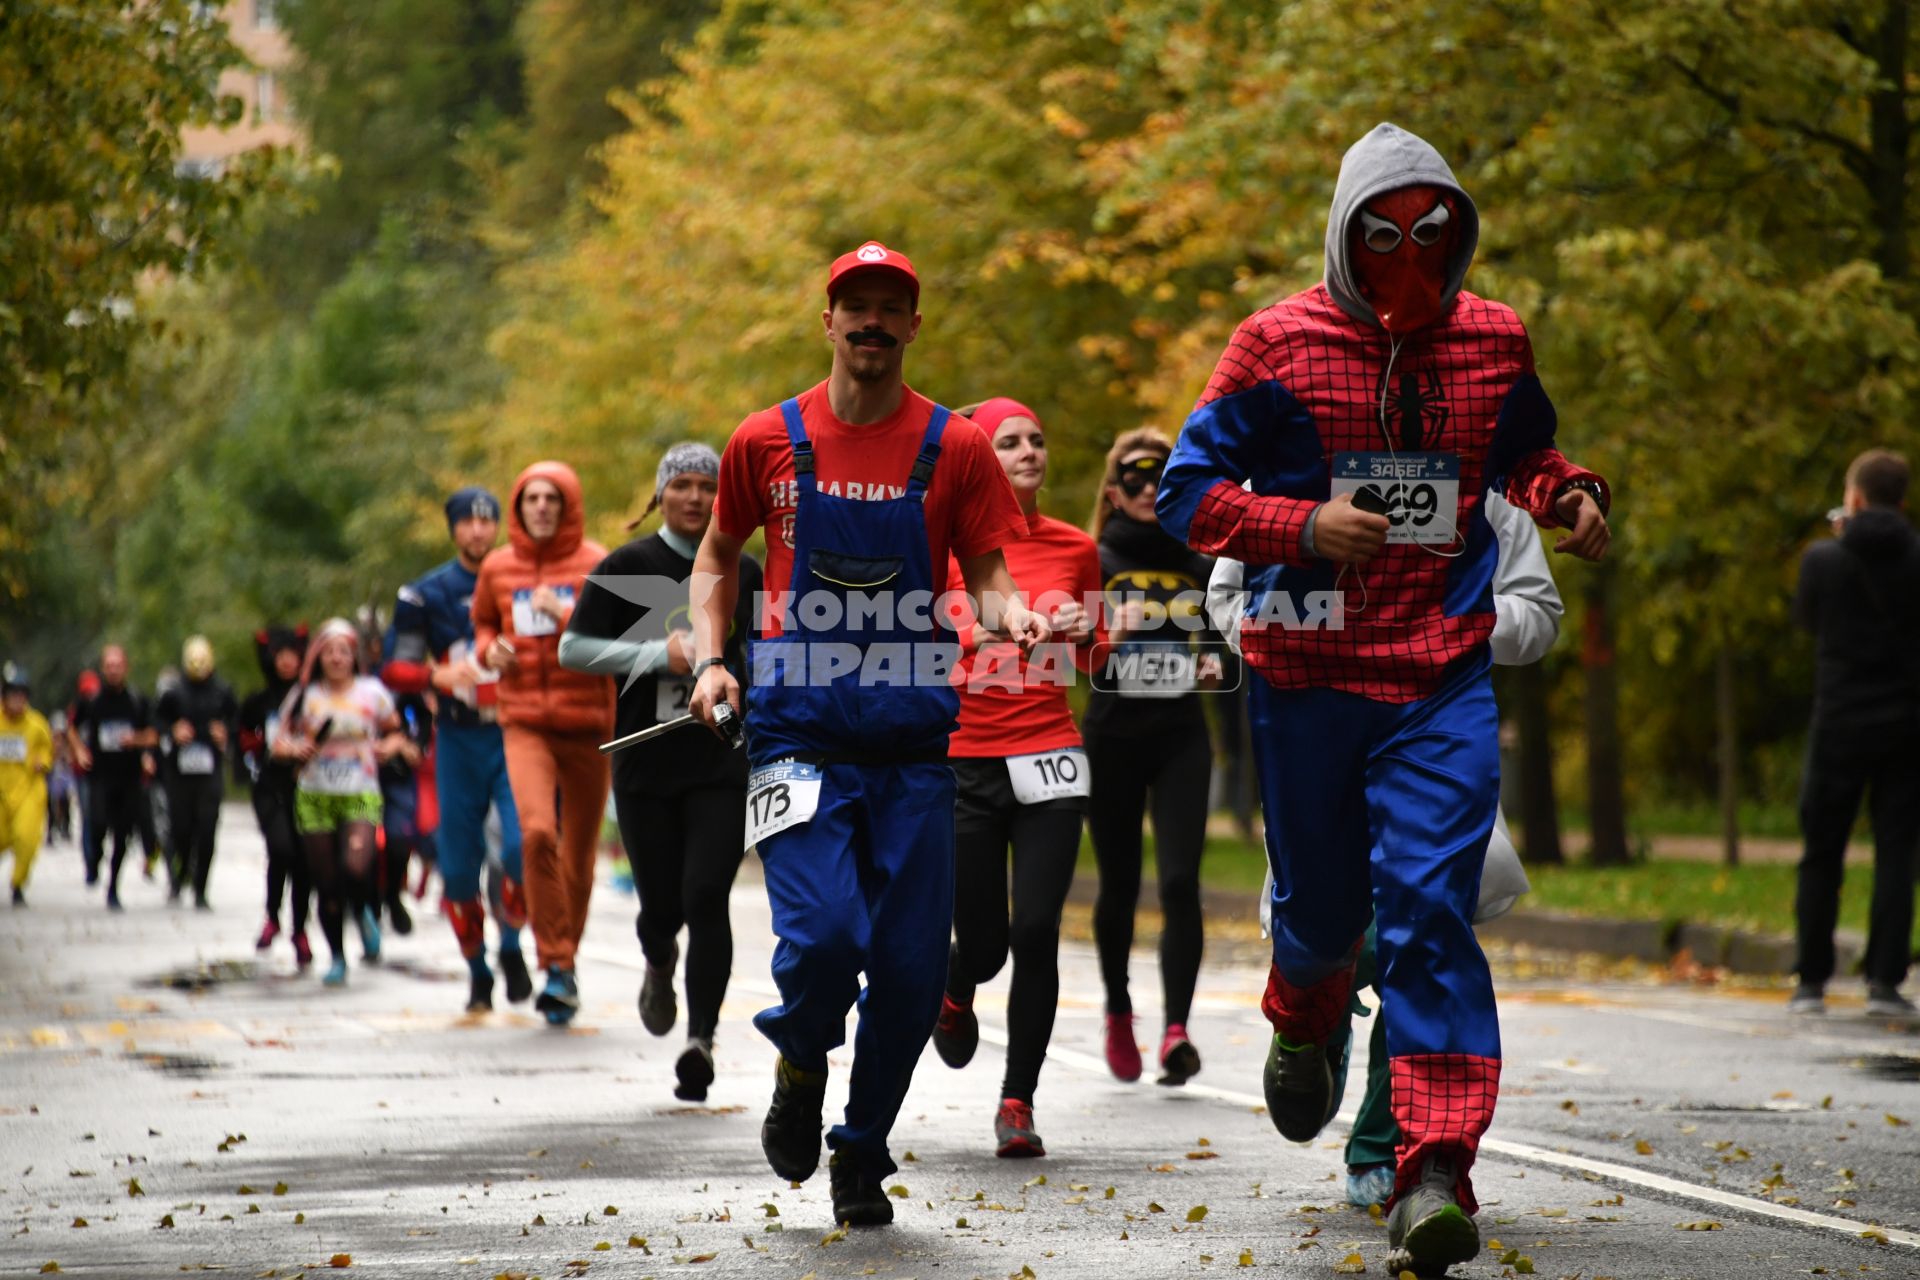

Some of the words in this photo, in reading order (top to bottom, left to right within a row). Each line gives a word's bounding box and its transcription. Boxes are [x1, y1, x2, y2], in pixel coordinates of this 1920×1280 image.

[861, 248, 883, 258] M
[1370, 464, 1427, 478] ЗАБЕГ
[749, 770, 793, 791] ЗАБЕГ
[1033, 755, 1078, 786] 110
[749, 783, 791, 828] 173
